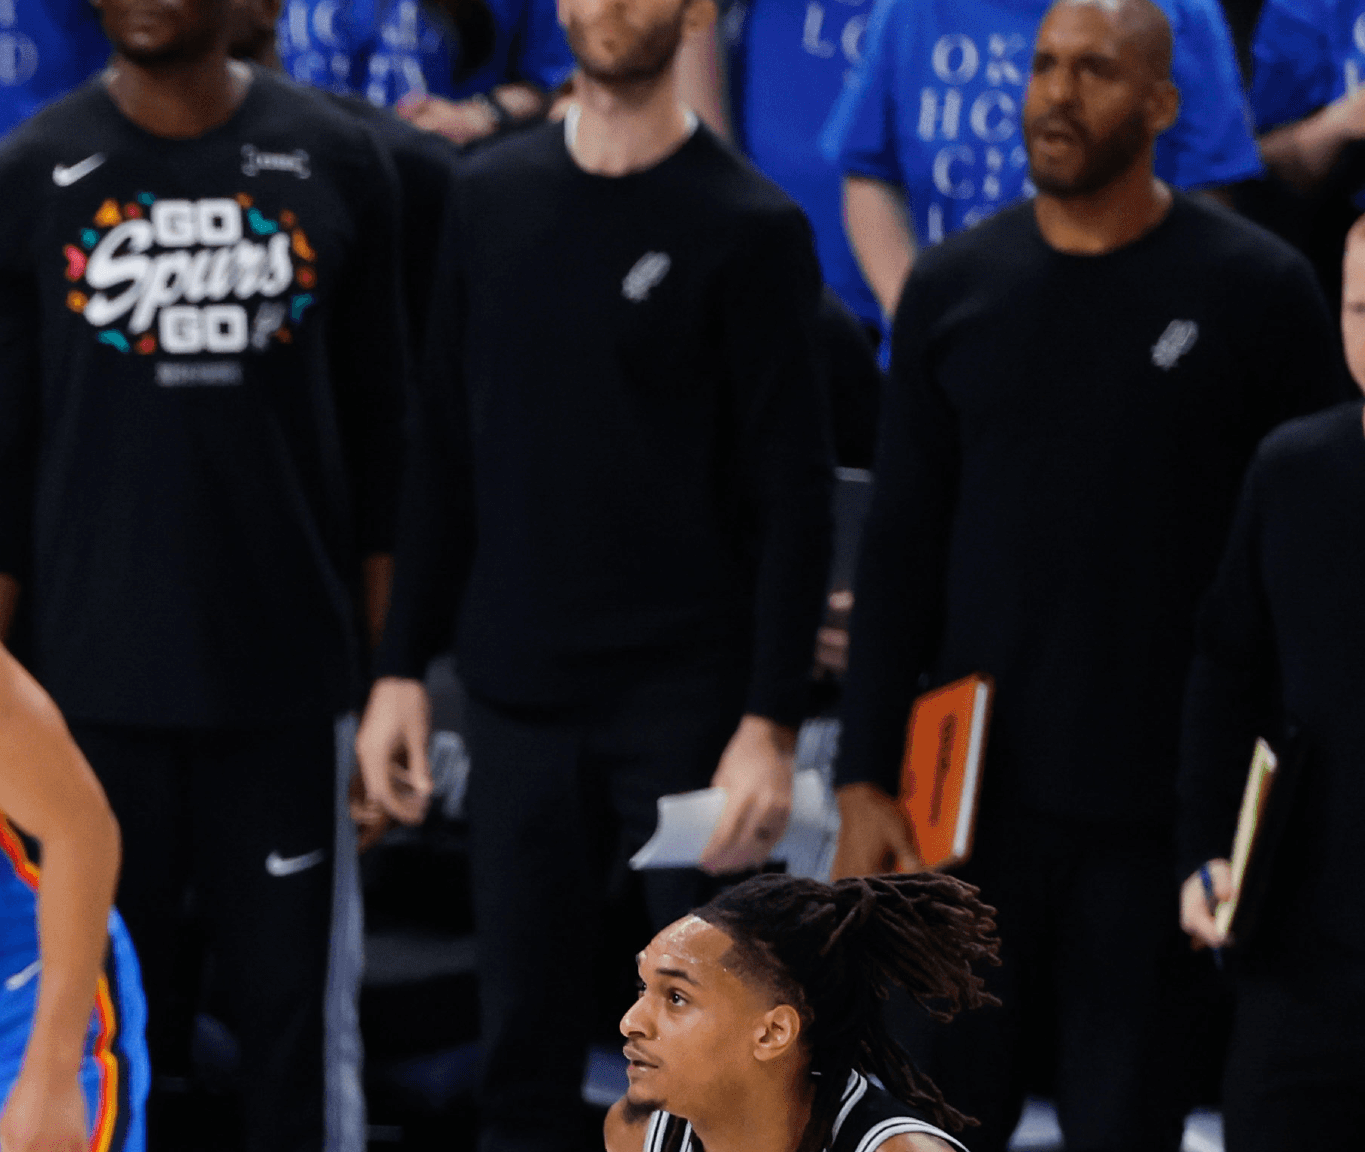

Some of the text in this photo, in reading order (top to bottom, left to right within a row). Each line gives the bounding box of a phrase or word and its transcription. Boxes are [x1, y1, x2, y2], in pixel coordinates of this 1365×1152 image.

[151, 197, 243, 247] GO
[83, 217, 294, 336] Spurs
[158, 303, 248, 354] GO
